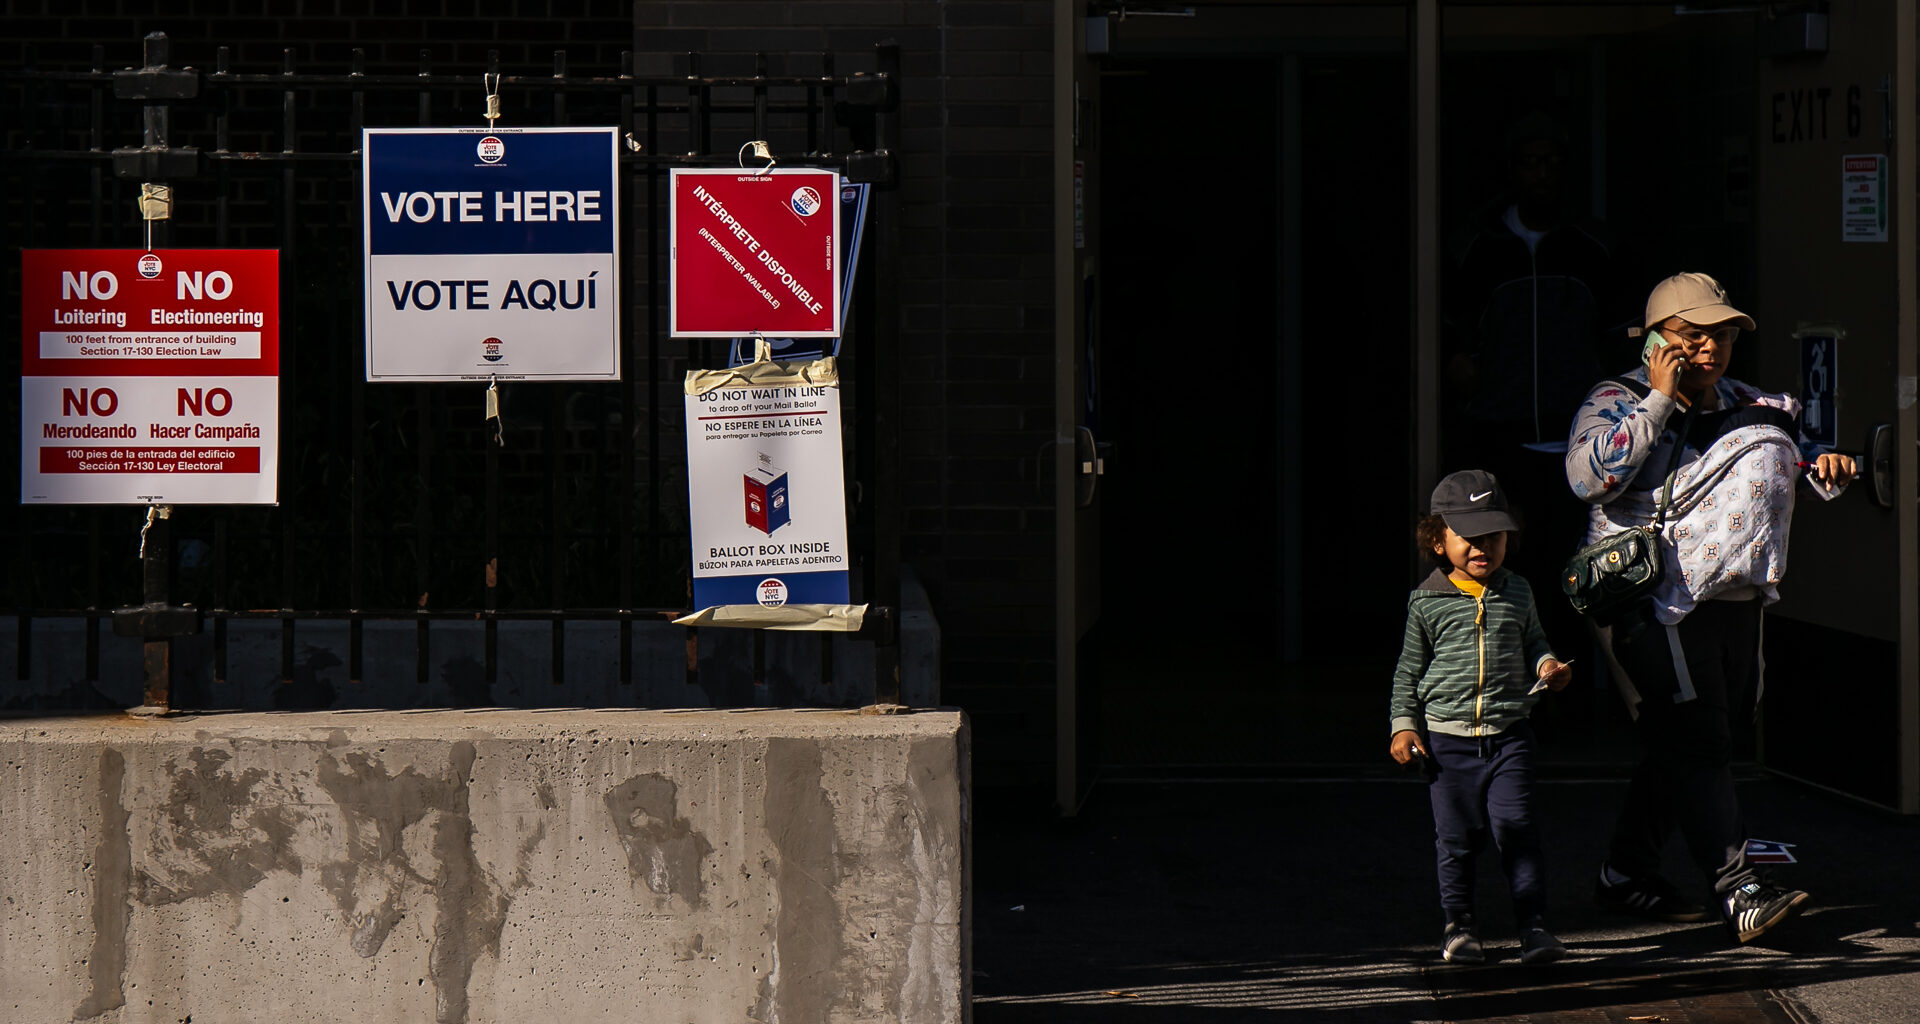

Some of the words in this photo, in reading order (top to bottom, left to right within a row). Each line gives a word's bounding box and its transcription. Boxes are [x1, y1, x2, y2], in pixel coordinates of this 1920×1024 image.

[1773, 88, 1830, 143] EXIT
[1847, 86, 1860, 137] 6
[380, 191, 484, 223] VOTE
[495, 190, 601, 222] HERE
[693, 185, 761, 253] INTÉRPRETE
[757, 249, 823, 315] DISPONIBLE
[698, 227, 746, 275] (INTERPRETER
[743, 272, 780, 310] AVAILABLE)
[62, 271, 118, 300] NO
[177, 271, 233, 300] NO
[387, 280, 490, 311] VOTE
[500, 270, 599, 312] AQUÍ
[54, 309, 127, 328] Loitering
[151, 309, 264, 328] Electioneering
[65, 335, 83, 344] 100
[85, 335, 106, 344] feet
[108, 335, 132, 344] from
[134, 336, 180, 344] entrance
[183, 335, 194, 344] of
[195, 335, 237, 346] building
[80, 347, 119, 356] Section
[122, 347, 153, 356] 17-130
[156, 347, 197, 356] Election
[200, 347, 222, 356] Law
[62, 387, 119, 417] NO
[177, 387, 233, 417] NO
[700, 392, 718, 402] DO
[722, 390, 747, 401] NOT
[751, 389, 780, 399] WAIT
[784, 388, 797, 398] IN
[801, 387, 826, 397] LINE
[719, 405, 739, 413] drop
[774, 402, 791, 410] Mail
[42, 423, 137, 439] Merodeando
[150, 423, 191, 439] Hacer
[195, 423, 260, 442] Campaña
[705, 423, 721, 431] NO
[725, 421, 759, 430] ESPERE
[762, 420, 775, 428] EN
[779, 419, 791, 428] LA
[794, 417, 822, 427] LÍNEA
[66, 450, 84, 459] 100
[86, 450, 108, 460] pies
[110, 450, 123, 459] de
[126, 450, 135, 459] la
[137, 450, 177, 459] entrada
[180, 450, 195, 459] del
[198, 450, 235, 459] edificio
[79, 461, 120, 471] Sección
[123, 462, 154, 471] 17-130
[157, 462, 175, 472] Ley
[178, 461, 223, 471] Electoral
[710, 546, 755, 558] BALLOT
[759, 544, 785, 556] BOX
[790, 542, 830, 554] INSIDE
[699, 560, 728, 570] BÚZON
[730, 560, 753, 568] PARA
[756, 557, 800, 567] PAPELETAS
[802, 555, 842, 564] ADENTRO
